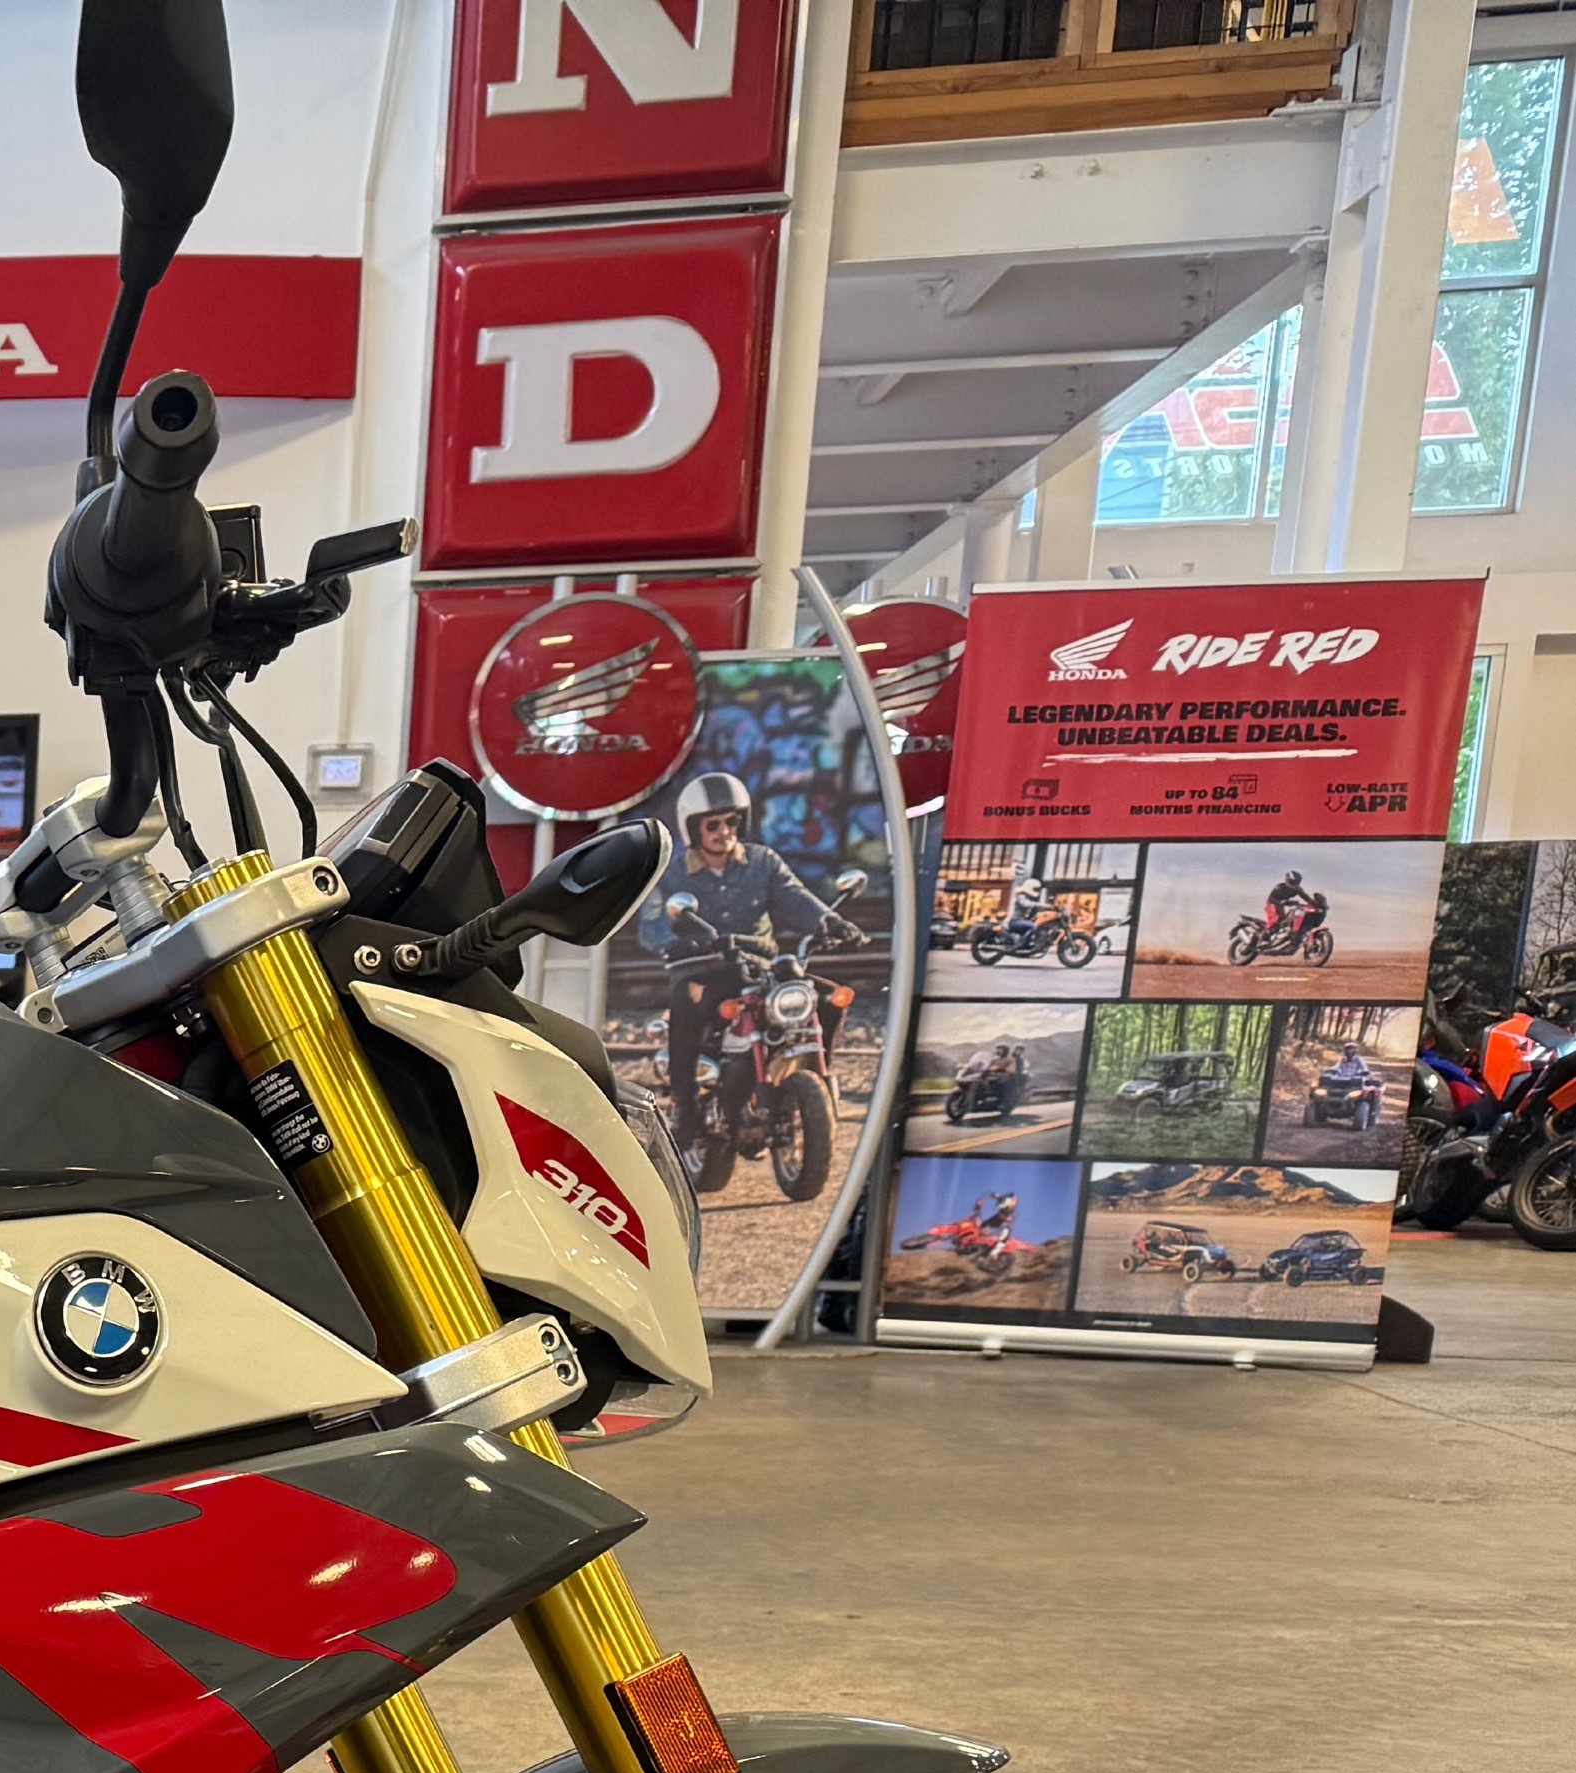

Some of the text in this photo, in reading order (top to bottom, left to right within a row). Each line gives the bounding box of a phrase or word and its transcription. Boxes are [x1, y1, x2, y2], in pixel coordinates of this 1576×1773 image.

[1152, 626, 1380, 677] RIDE RED
[1048, 669, 1128, 682] HONDA
[1007, 697, 1406, 725] LEGENDARY PERFORMANCE.
[514, 733, 653, 756] HONDA
[1057, 722, 1347, 748] UNBEATABLE DEALS.
[1165, 786, 1239, 801] UP TO 84
[1326, 782, 1409, 794] LOW-RATE
[983, 804, 1091, 817] BONUS BUCKS
[1129, 803, 1282, 816] MONTHS FINANCING
[1347, 794, 1408, 813] APR
[532, 1159, 628, 1235] 310
[60, 1259, 157, 1314] BMW
